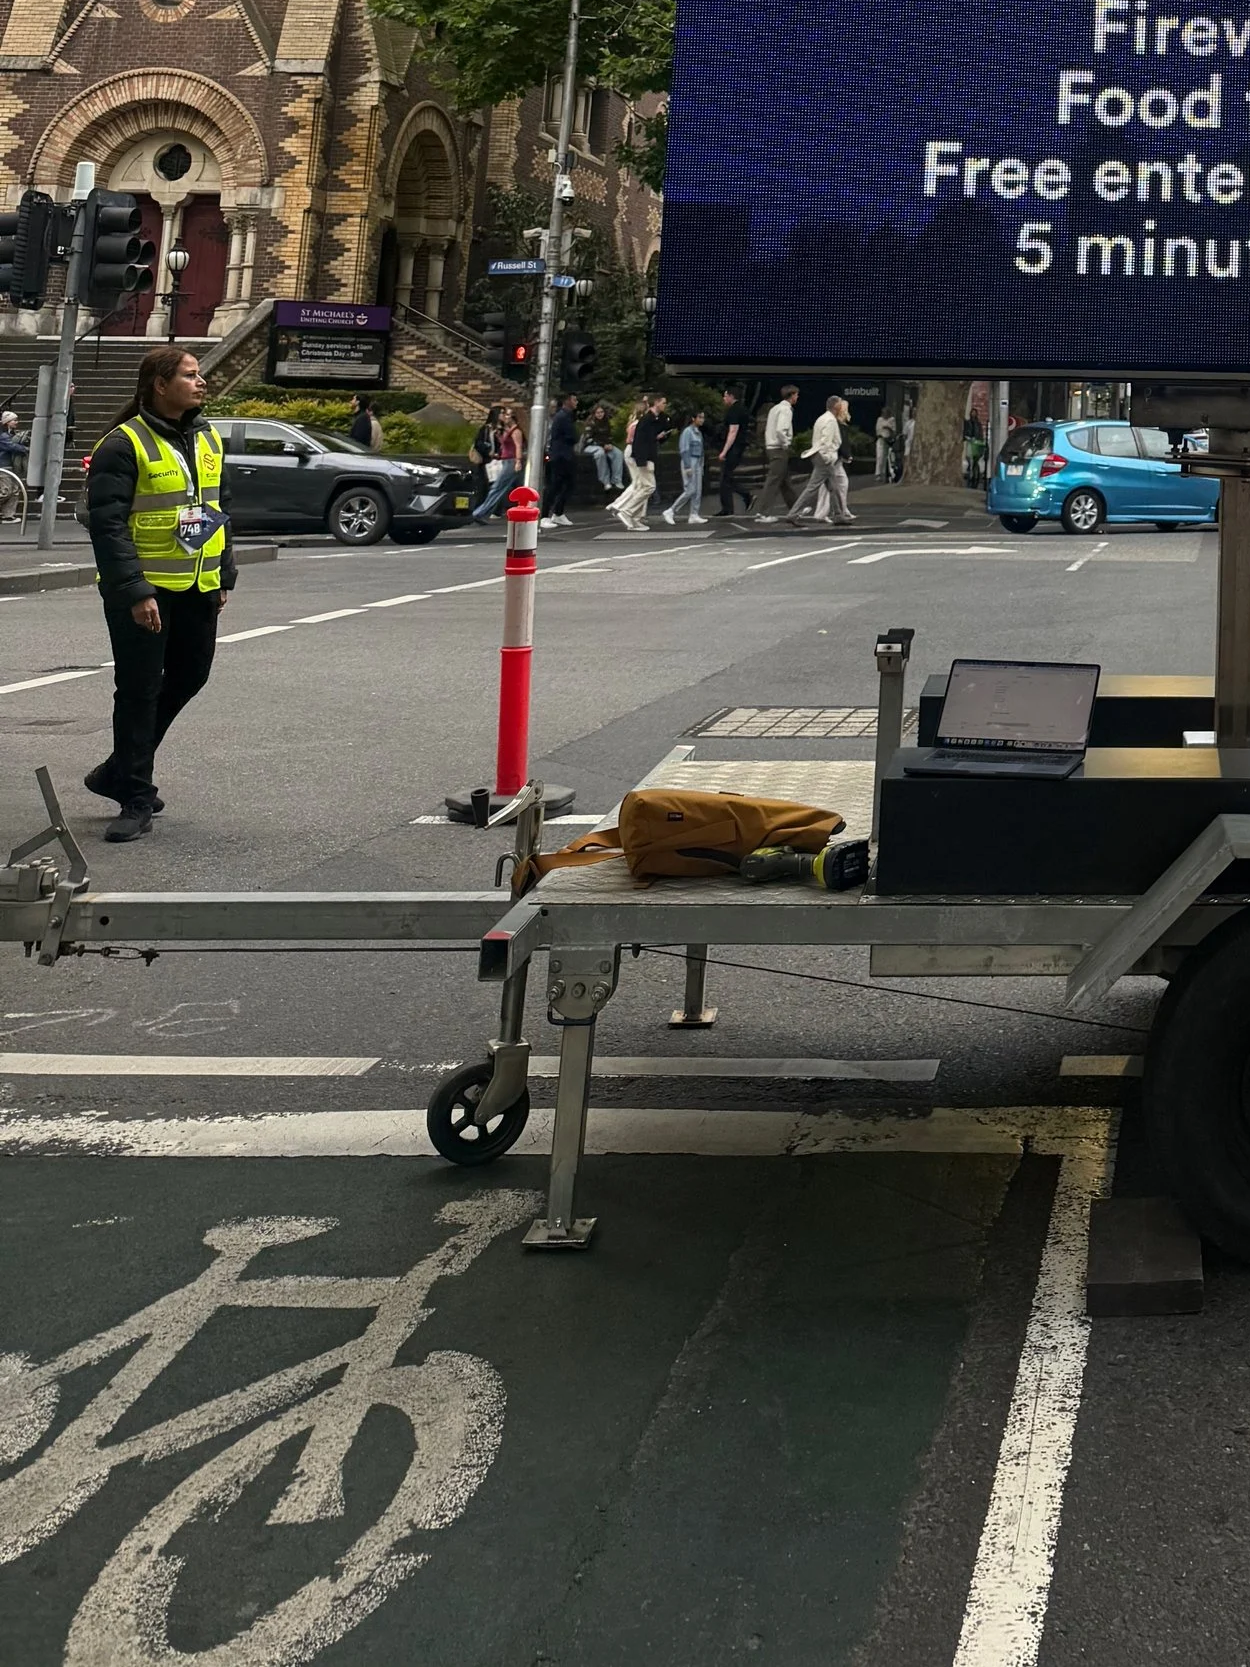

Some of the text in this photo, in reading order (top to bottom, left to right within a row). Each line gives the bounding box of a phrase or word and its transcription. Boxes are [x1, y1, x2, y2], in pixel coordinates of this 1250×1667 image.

[1057, 70, 1223, 129] Food
[923, 141, 1073, 200] Free
[1014, 221, 1053, 274] 5
[497, 260, 537, 270] Russell St
[302, 342, 325, 350] Sunday
[301, 349, 332, 357] Christmas
[844, 387, 880, 396] simbuilt
[148, 470, 178, 480] Security
[181, 523, 200, 536] 748
